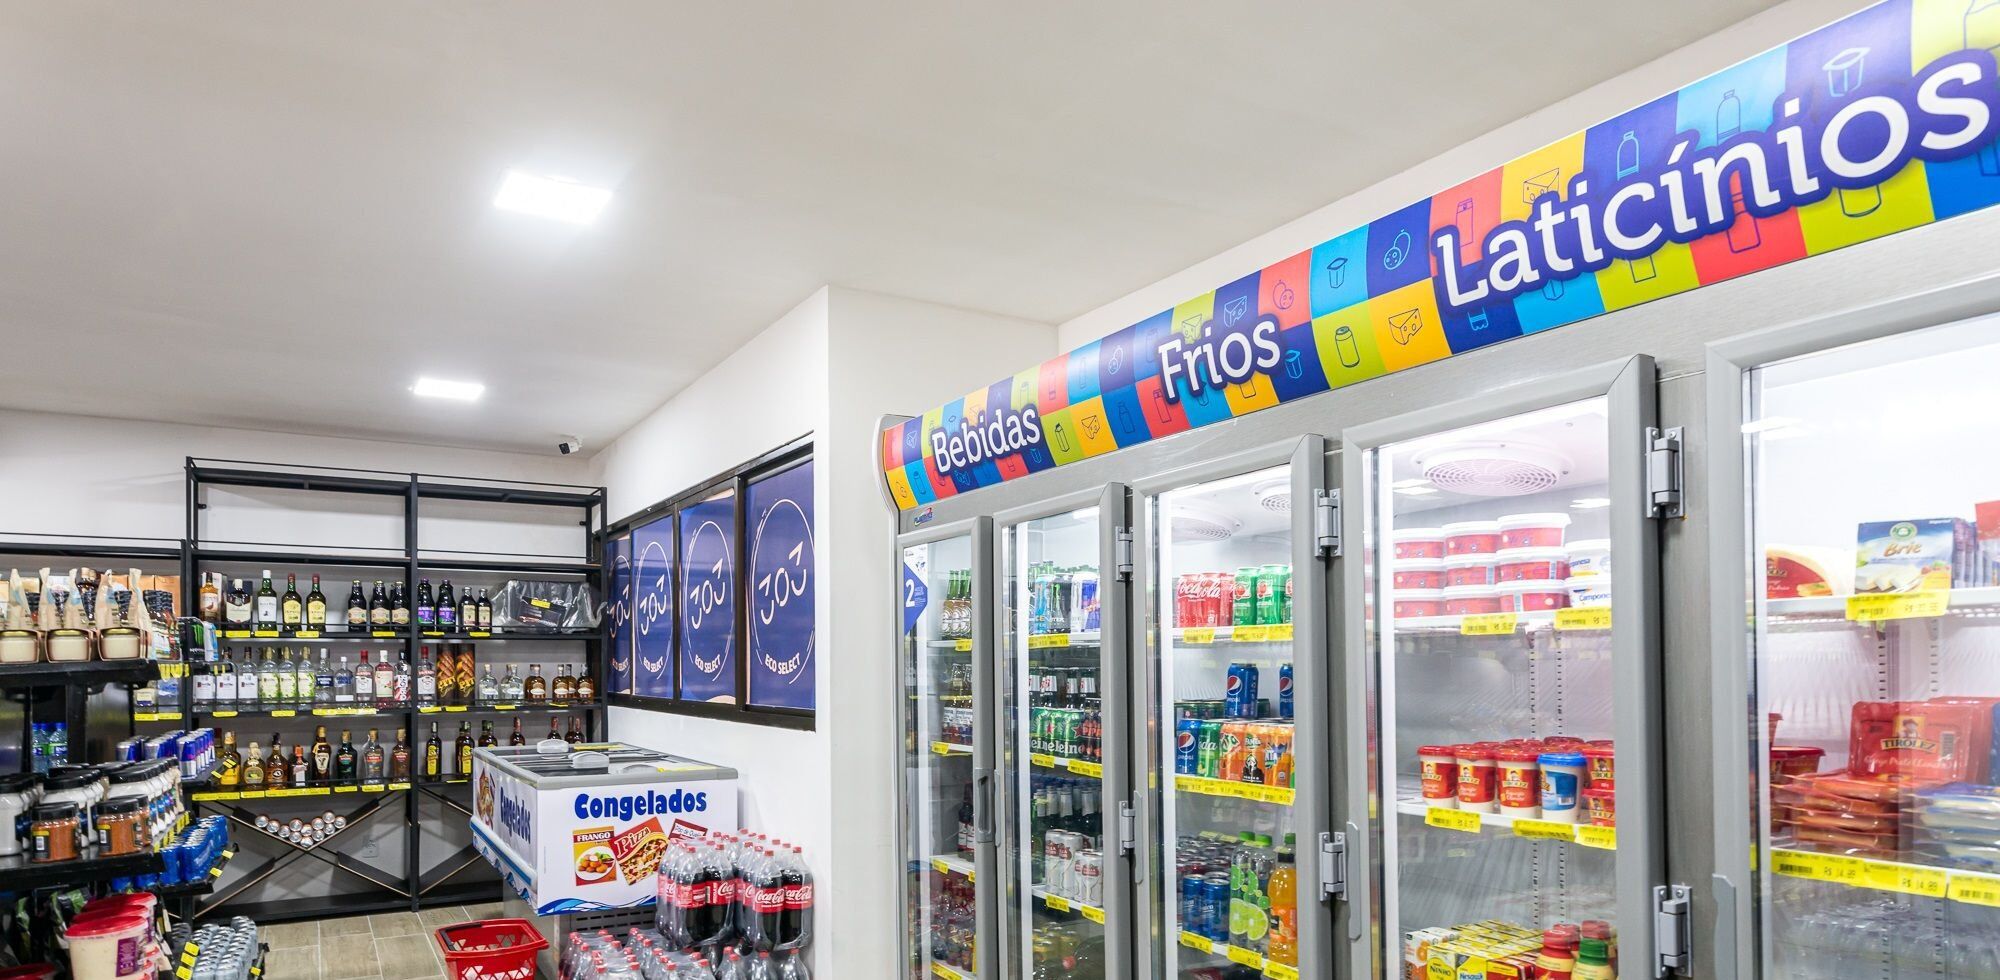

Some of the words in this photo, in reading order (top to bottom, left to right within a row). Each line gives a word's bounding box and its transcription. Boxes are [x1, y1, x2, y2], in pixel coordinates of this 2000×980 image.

[1436, 61, 1991, 307] Laticínios
[1158, 320, 1280, 399] Frios
[931, 406, 1041, 473] Bebidas
[1884, 541, 1922, 558] Brie
[905, 578, 916, 608] 2
[695, 654, 704, 671] ECO
[704, 654, 721, 673] SELECT
[765, 653, 777, 673] ECO
[778, 652, 800, 675] SELECT
[574, 788, 707, 822] Congelados
[576, 831, 612, 843] FRANGO
